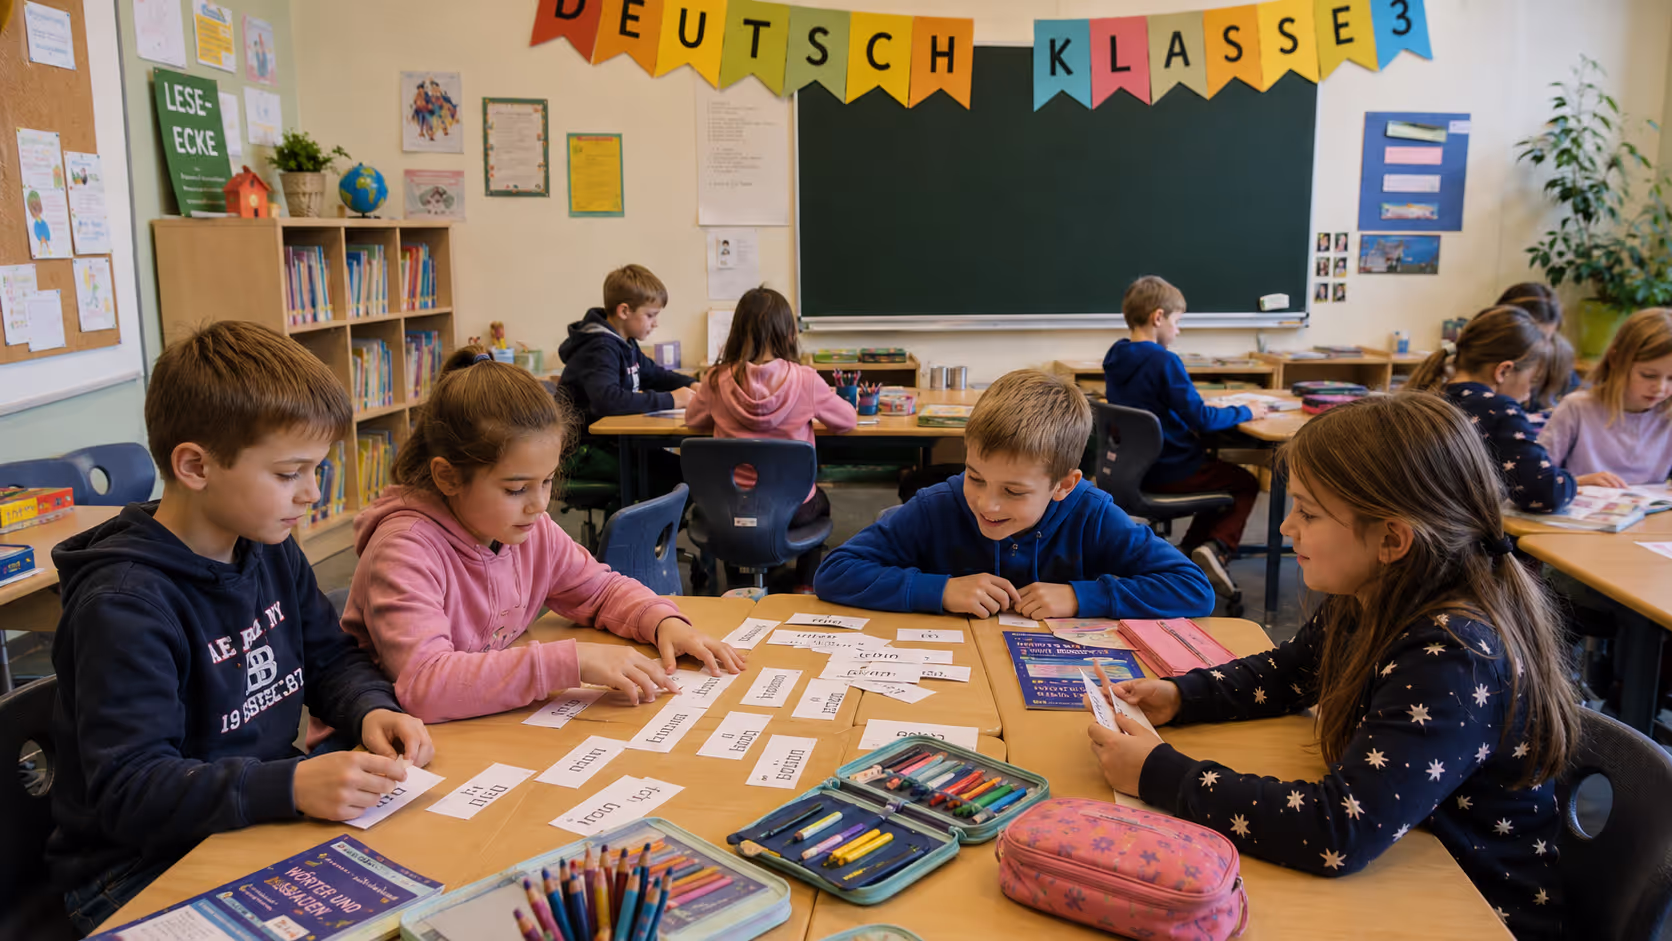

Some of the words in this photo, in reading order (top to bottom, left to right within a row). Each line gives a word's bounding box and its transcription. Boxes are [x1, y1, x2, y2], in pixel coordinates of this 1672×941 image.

[555, 0, 956, 74] DEUTSCH
[1049, 5, 1354, 76] KLASSE
[1390, 0, 1412, 36] 3
[164, 81, 212, 116] LESE-
[172, 126, 218, 156] ECKE
[330, 894, 362, 914] UND
